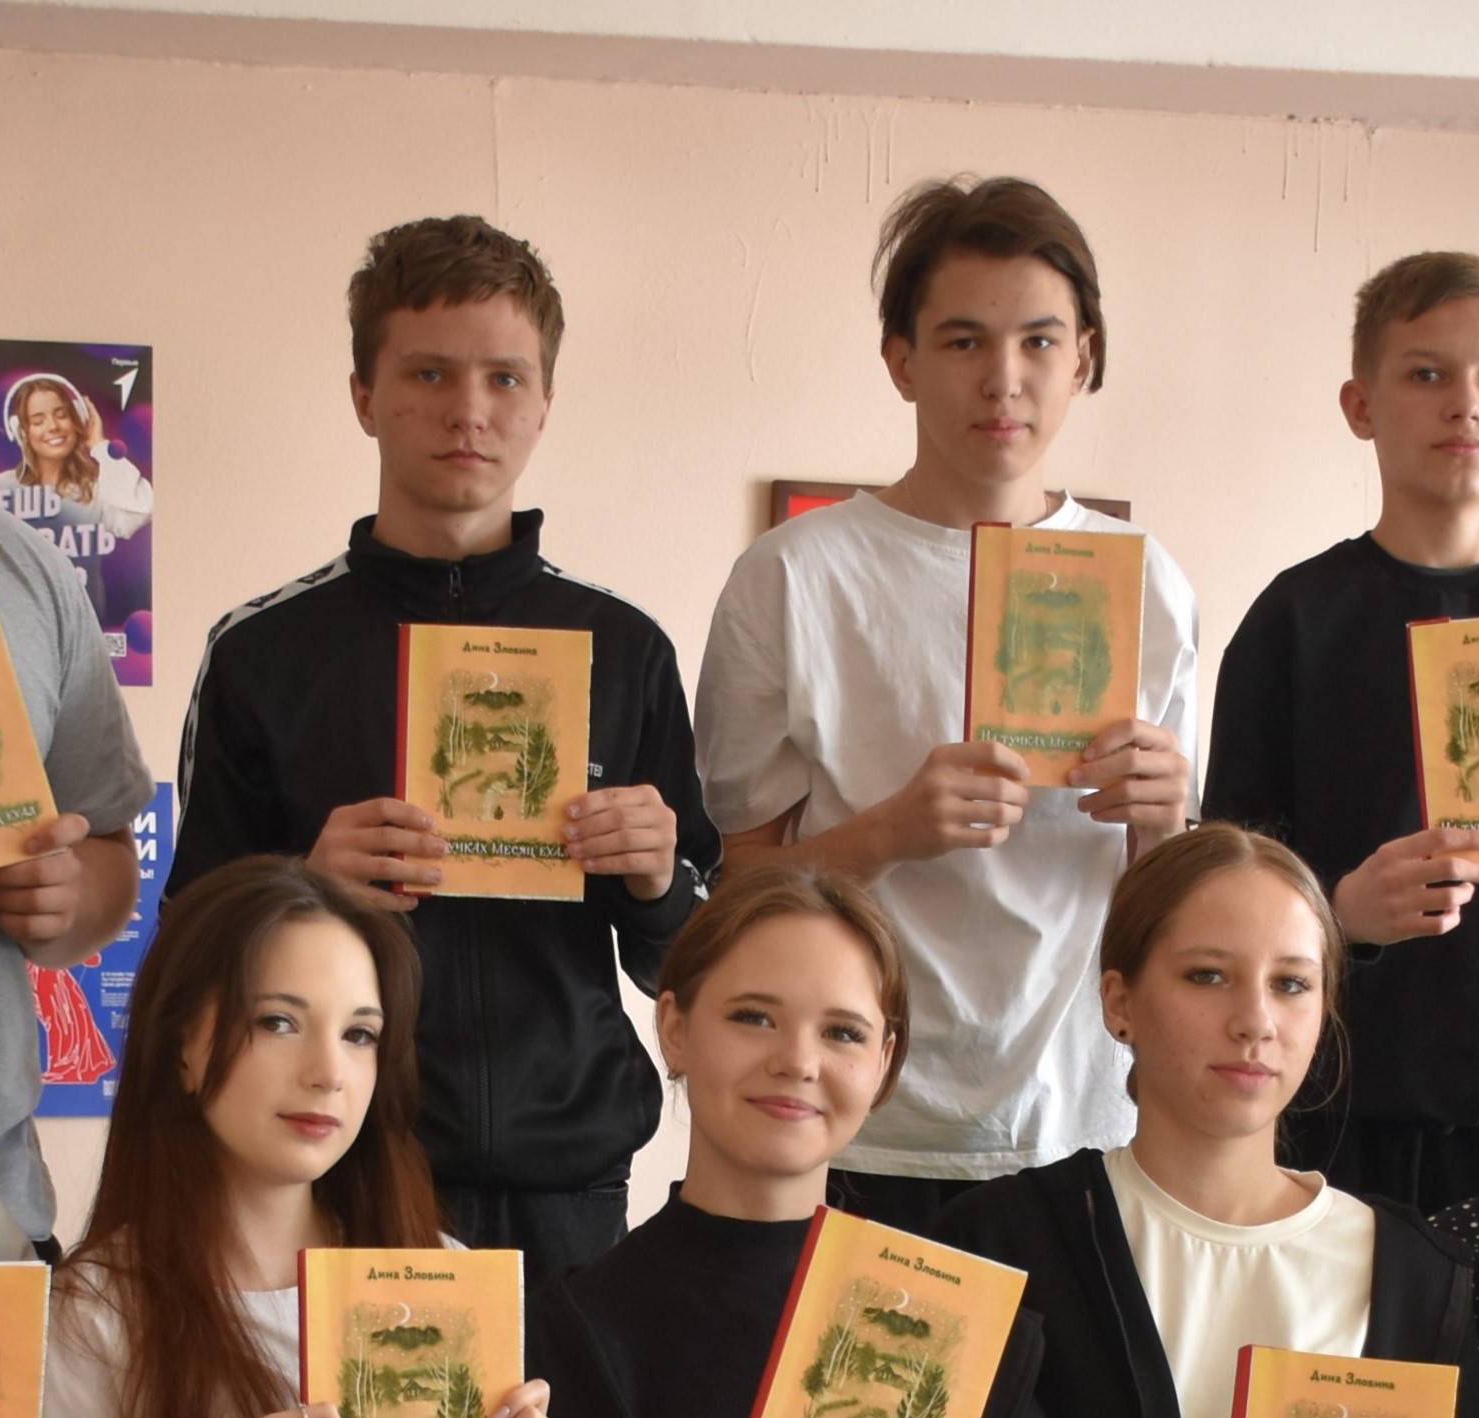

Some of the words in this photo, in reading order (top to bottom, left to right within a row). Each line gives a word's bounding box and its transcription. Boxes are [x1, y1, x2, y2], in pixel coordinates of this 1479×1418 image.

[878, 1246, 911, 1269] Дина
[367, 1266, 400, 1281] Дина
[1310, 1368, 1342, 1385] Дина
